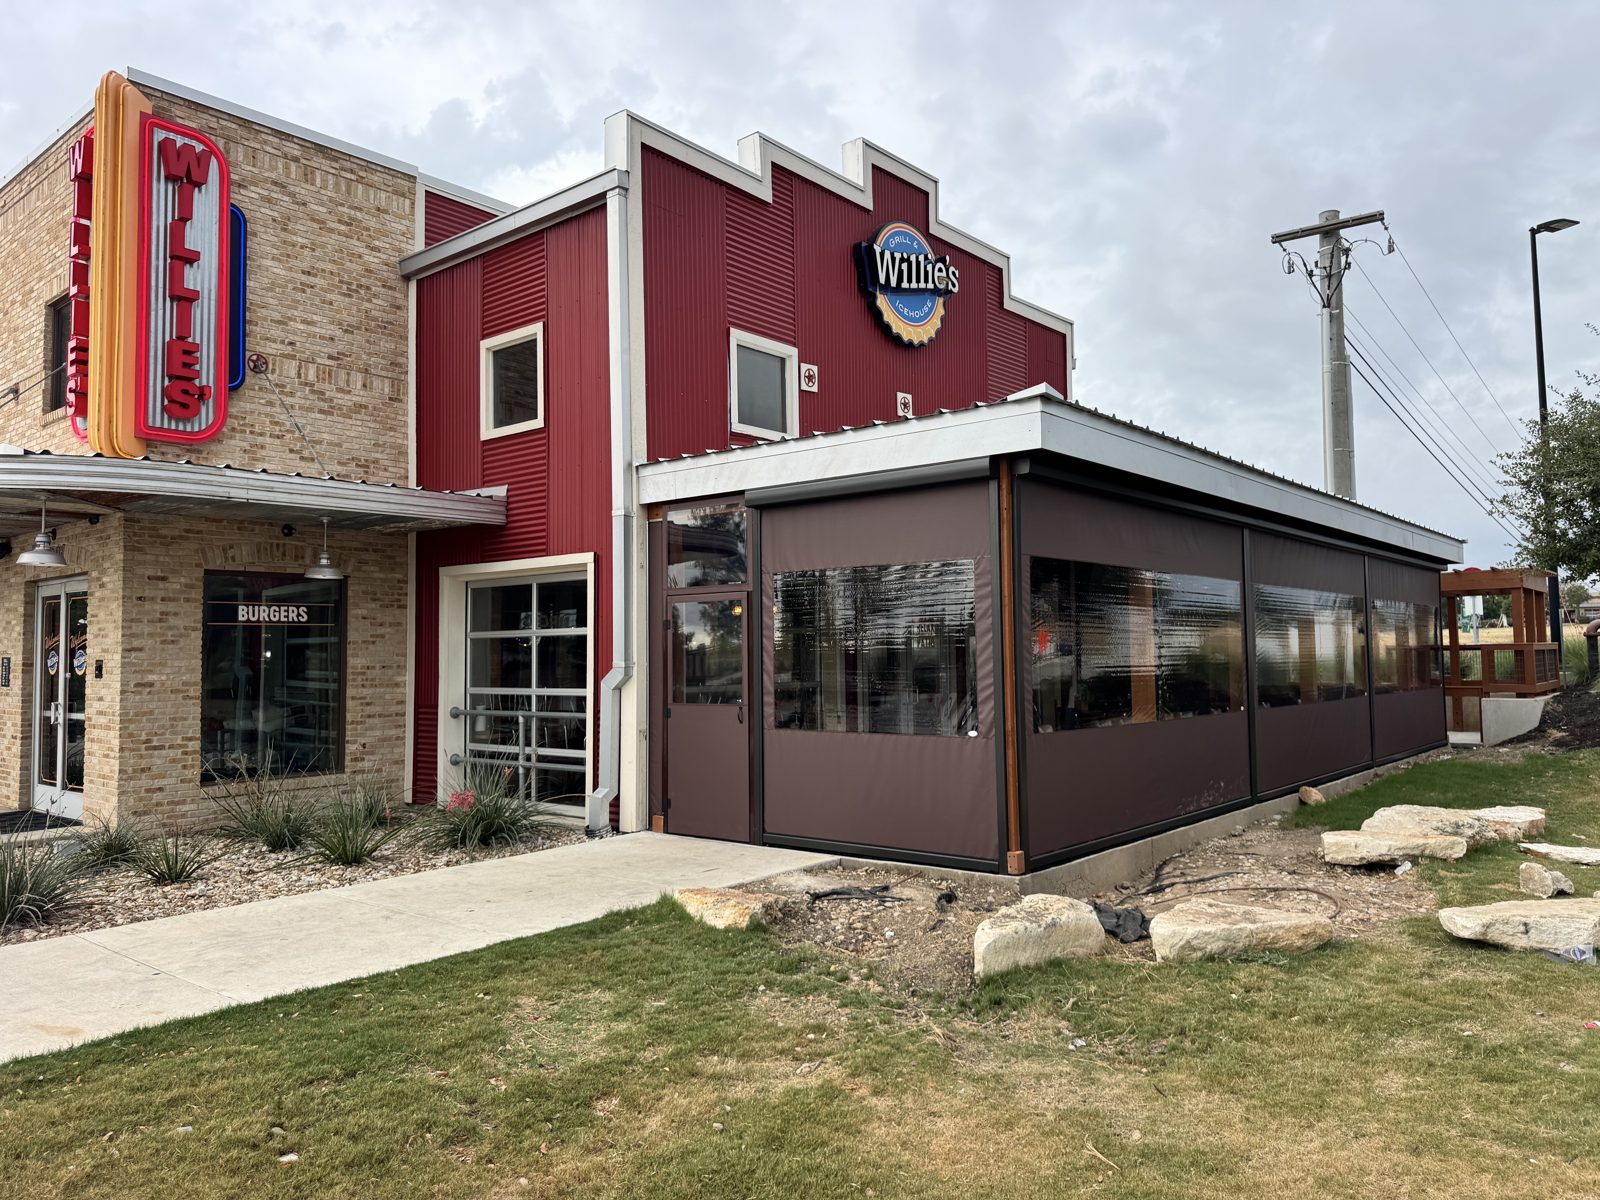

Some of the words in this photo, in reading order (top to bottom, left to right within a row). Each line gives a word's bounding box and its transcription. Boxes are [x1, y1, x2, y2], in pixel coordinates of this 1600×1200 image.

[889, 235, 911, 247] GRILL
[913, 241, 918, 249] &
[873, 243, 959, 293] Willie's
[895, 299, 932, 318] ICEHOUSE
[238, 605, 308, 622] BURGERS
